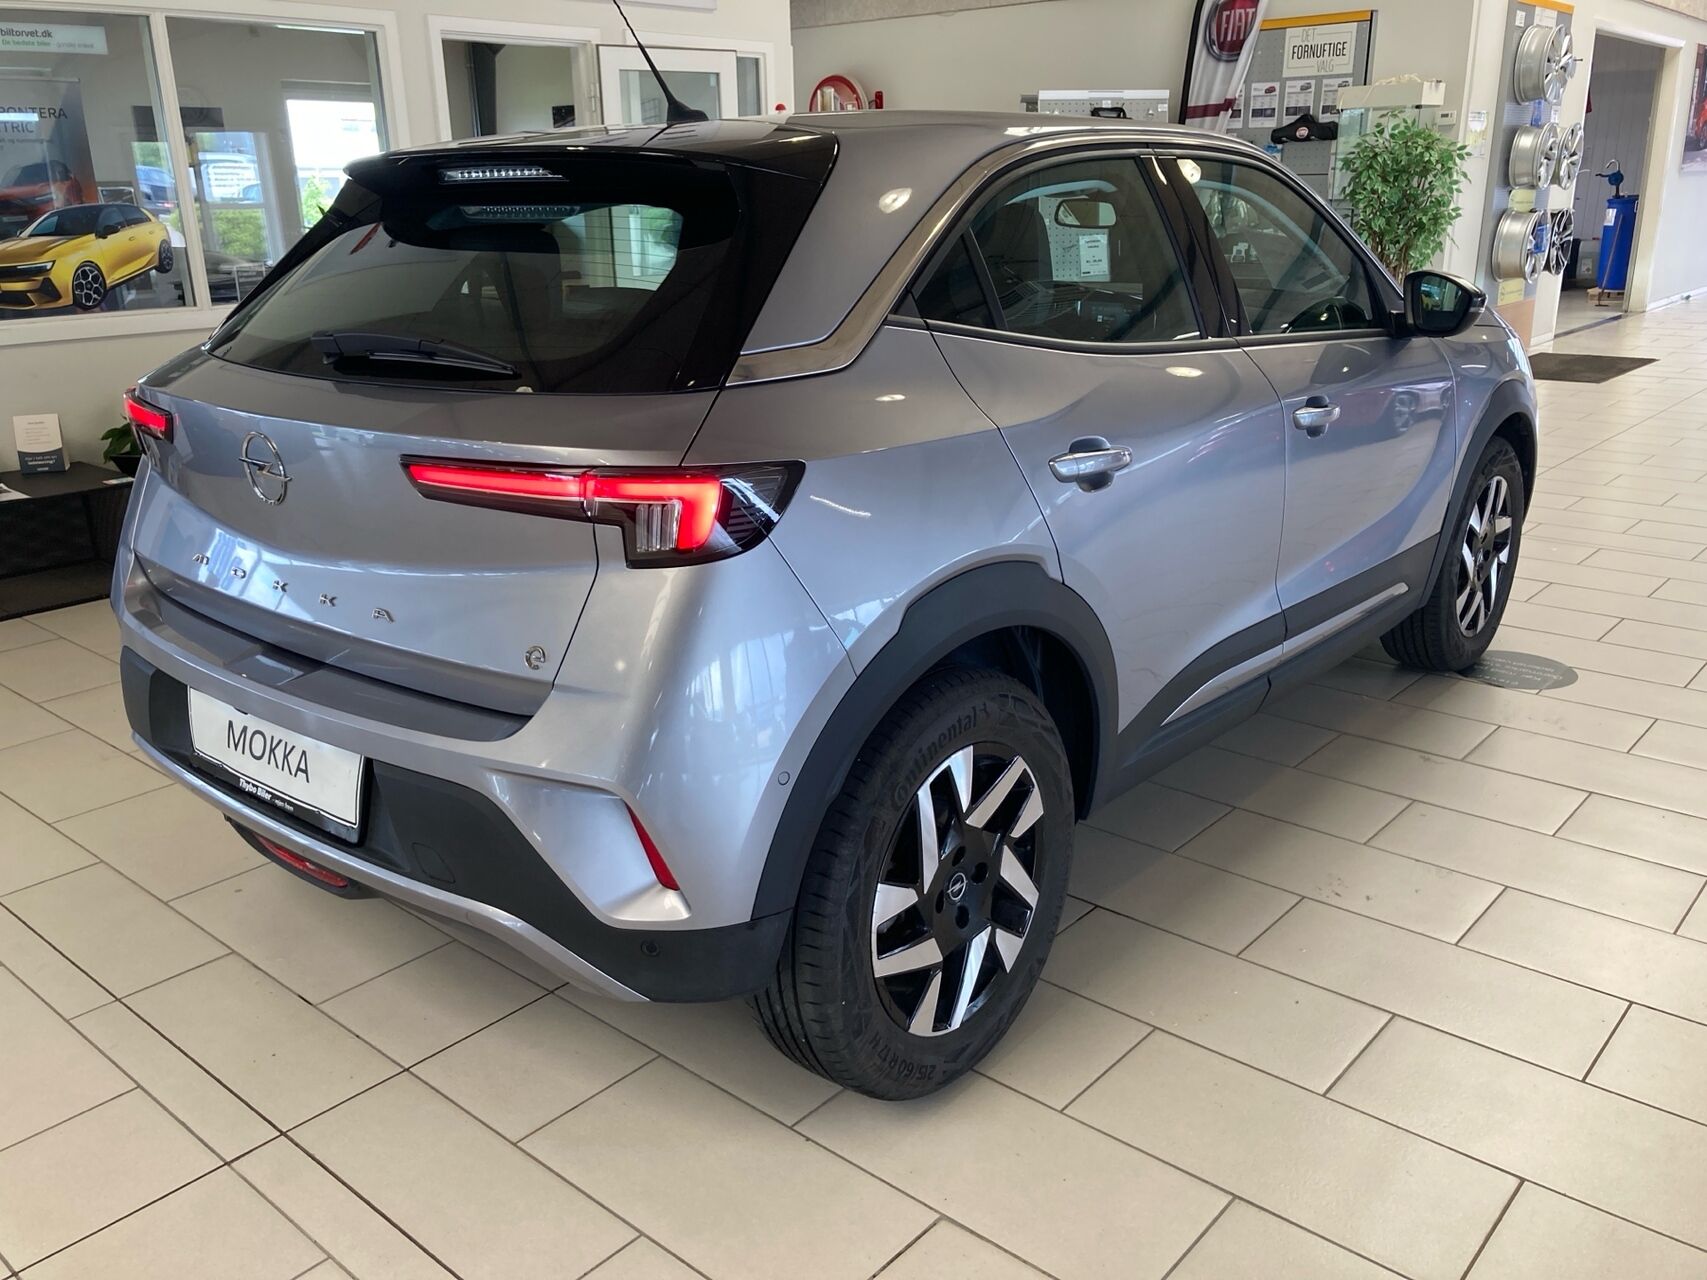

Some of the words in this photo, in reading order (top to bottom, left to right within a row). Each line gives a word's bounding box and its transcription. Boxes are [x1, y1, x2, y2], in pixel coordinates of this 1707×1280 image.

[1220, 8, 1255, 42] FIAT
[1301, 28, 1317, 42] DET
[1291, 41, 1348, 60] FORNUFTIGE
[1316, 59, 1334, 73] VALG
[0, 121, 34, 133] TRIC
[227, 720, 310, 784] MOKKA
[893, 705, 977, 810] Continental
[240, 778, 257, 793] Thybo
[257, 787, 272, 801] Biler
